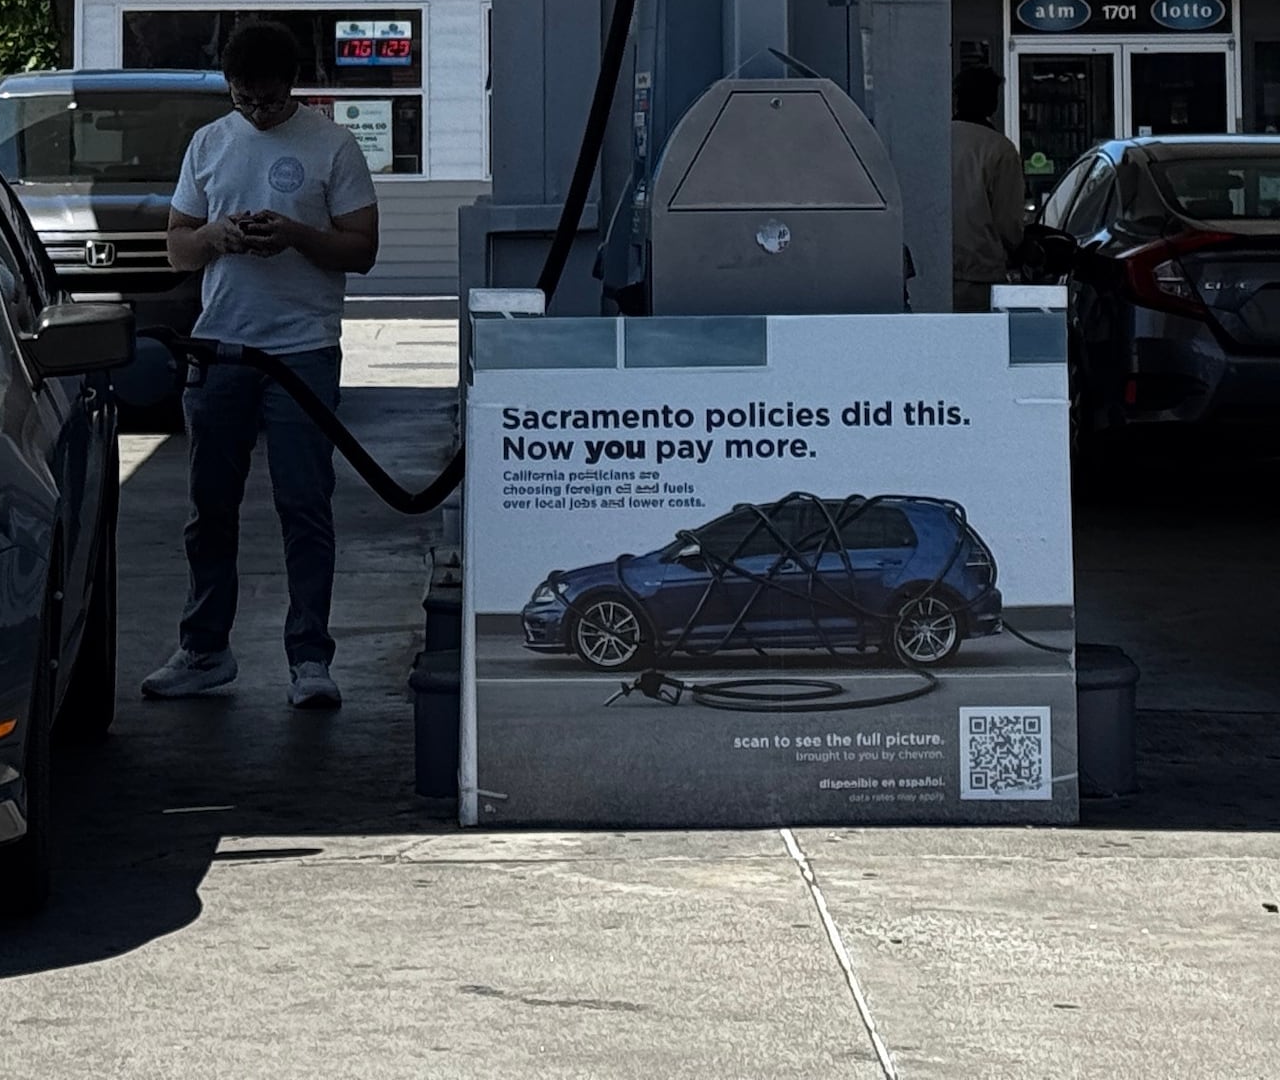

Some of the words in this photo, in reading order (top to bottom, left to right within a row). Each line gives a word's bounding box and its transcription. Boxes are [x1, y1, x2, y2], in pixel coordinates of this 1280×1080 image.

[1035, 2, 1075, 19] atm
[1102, 5, 1136, 20] 1701
[1162, 2, 1213, 19] lotto
[502, 404, 695, 431] Sacramento
[705, 402, 831, 433] policies
[841, 401, 893, 427] did
[904, 400, 971, 427] this.
[503, 437, 575, 461] Now
[584, 439, 646, 464] you
[656, 438, 713, 464] pay
[724, 435, 817, 460] more.
[503, 470, 565, 481] California
[503, 484, 562, 497] choosing
[565, 483, 612, 497] foreign
[663, 482, 695, 494] fuels
[503, 499, 531, 509] over
[535, 497, 566, 509] local
[569, 497, 597, 511] jobs
[600, 497, 625, 508] and
[628, 497, 664, 508] lower
[668, 496, 706, 508] costs.
[734, 735, 770, 749] scan
[774, 734, 791, 748] to
[795, 735, 822, 747] see
[826, 732, 852, 747] the
[856, 732, 881, 747] full
[886, 732, 945, 748] picture.
[796, 751, 840, 763] brought
[843, 750, 855, 761] to
[858, 751, 879, 762] you
[881, 750, 896, 762] by
[898, 749, 945, 760] chevron.
[881, 778, 896, 788] en
[898, 776, 945, 790] español.
